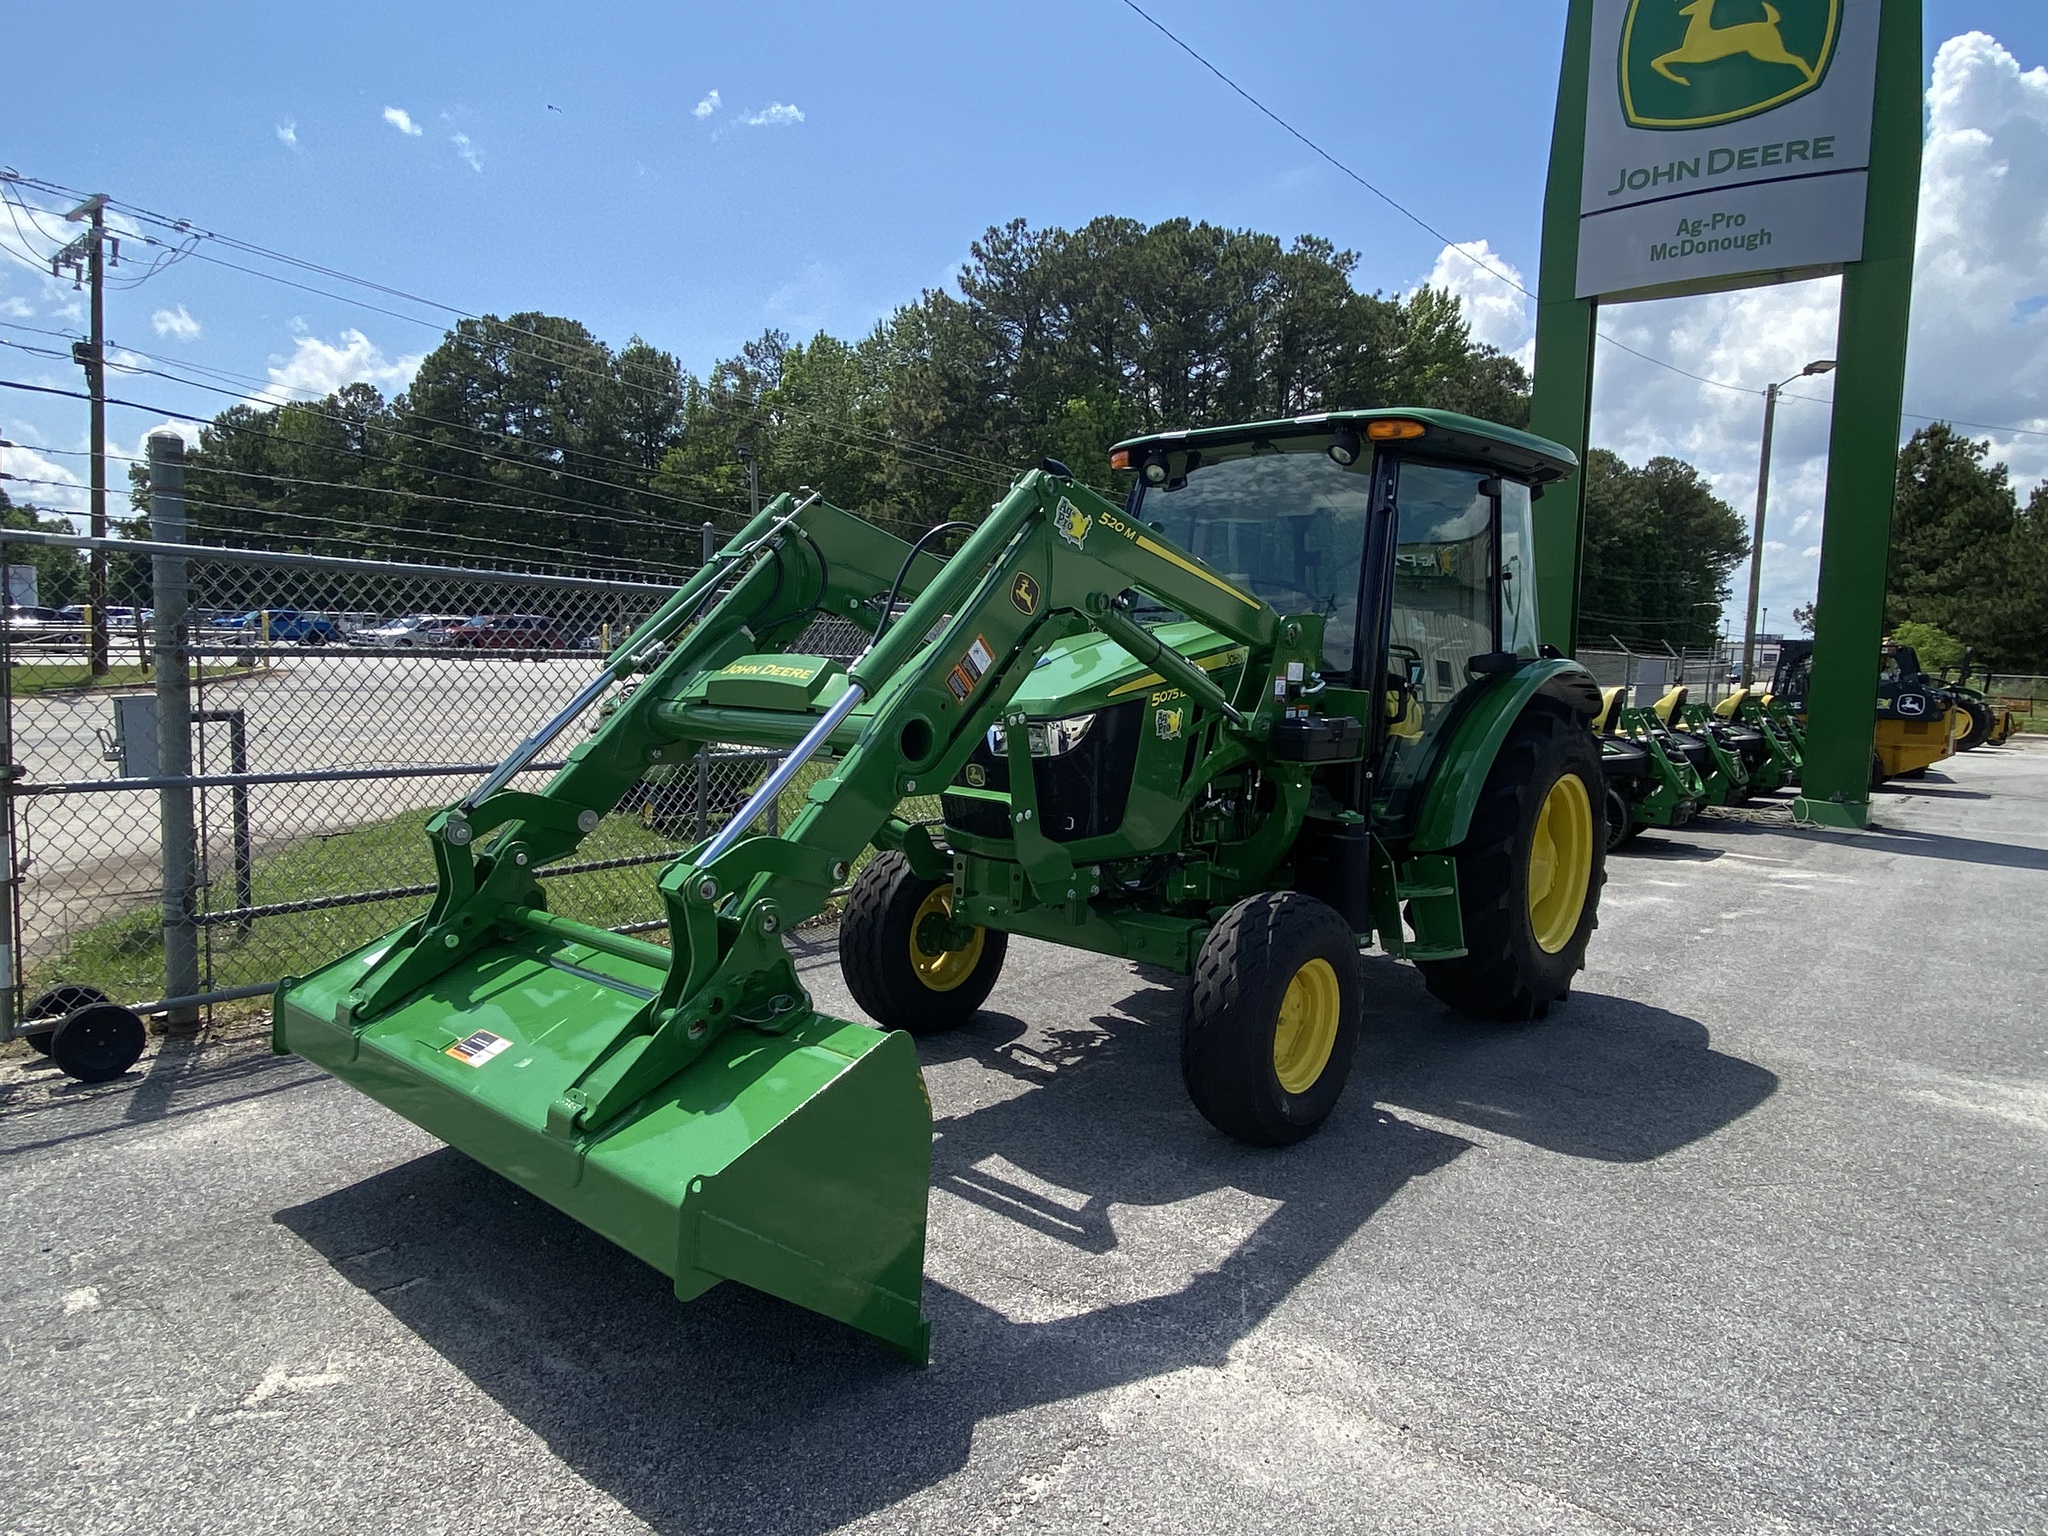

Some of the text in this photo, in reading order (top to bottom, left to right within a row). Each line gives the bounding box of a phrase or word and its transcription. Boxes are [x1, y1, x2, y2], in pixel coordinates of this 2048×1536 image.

[1608, 136, 1835, 196] JOHN DEERE
[1676, 212, 1746, 237] Ag-Pro
[1650, 228, 1772, 261] McDonough
[721, 664, 815, 679] JOHN DEERE
